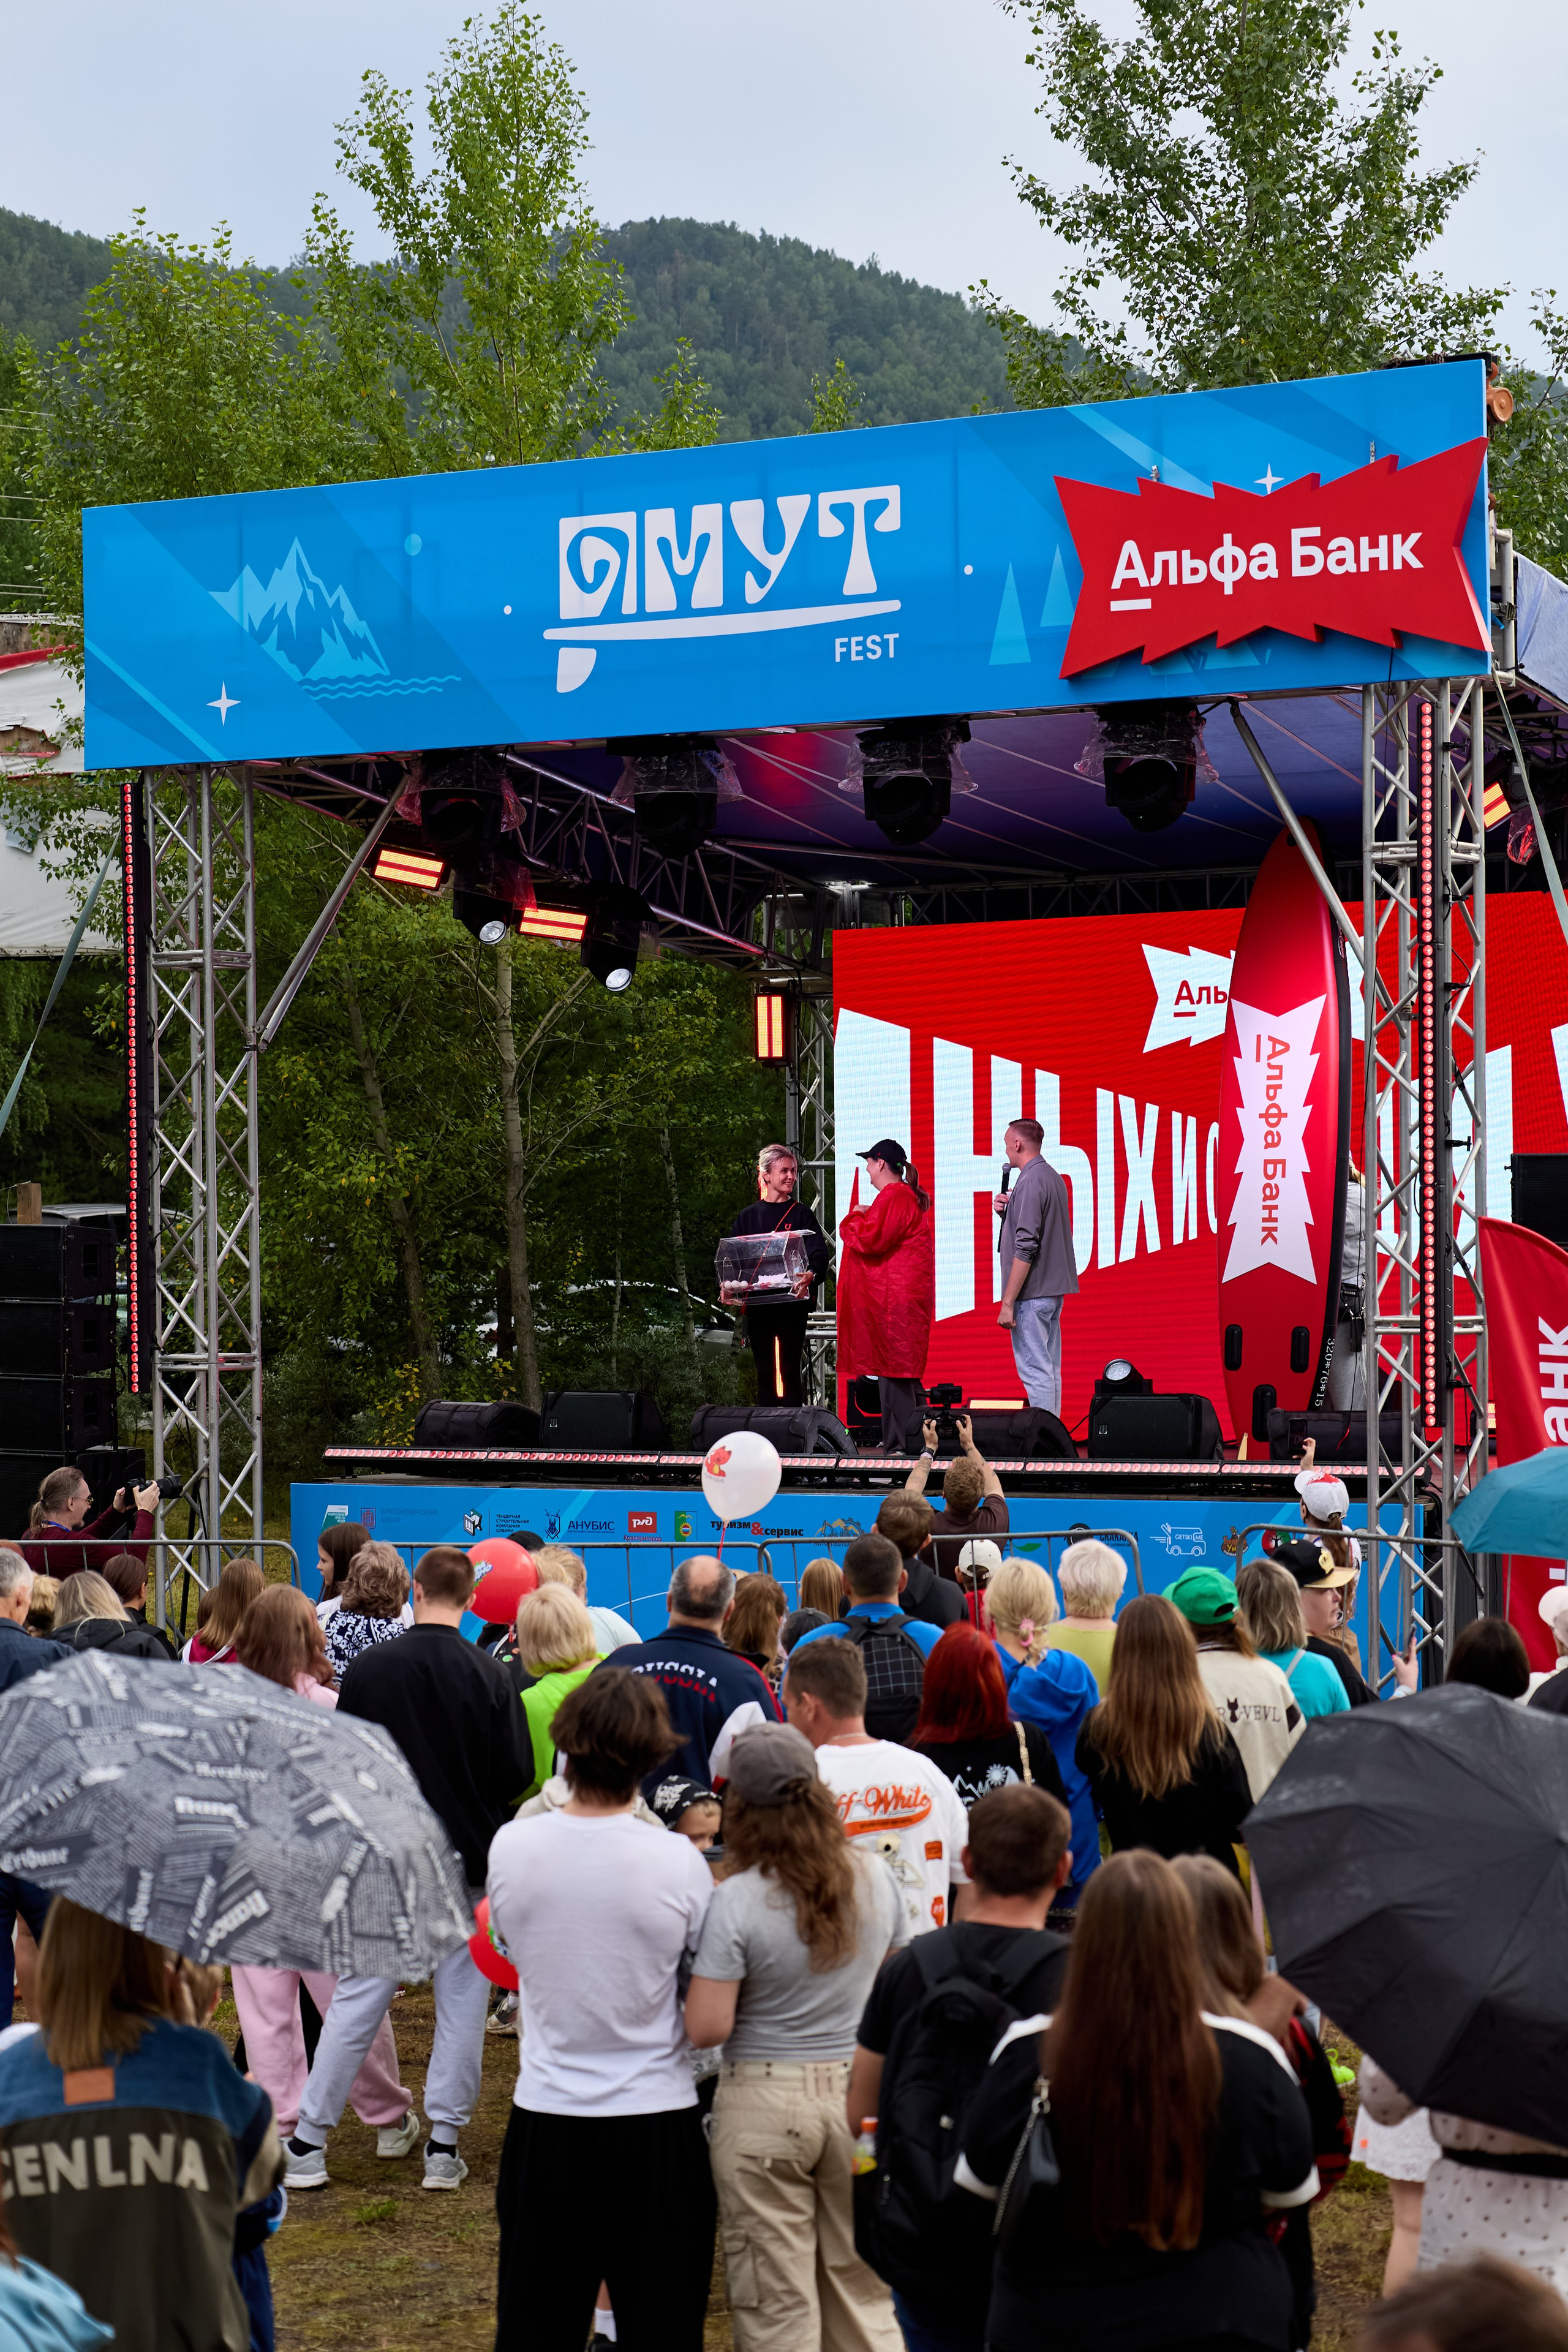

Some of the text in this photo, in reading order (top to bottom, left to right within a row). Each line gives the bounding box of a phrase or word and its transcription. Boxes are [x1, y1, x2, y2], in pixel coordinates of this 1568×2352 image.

[1110, 526, 1424, 596] Альфа Банк
[835, 633, 900, 663] FEST
[1174, 979, 1228, 1006] Аль
[1259, 1035, 1291, 1246] Альфа Банк
[1537, 1316, 1568, 1450] анк
[381, 1507, 438, 1516] КРАСНОЯРСКИЙ
[568, 1520, 615, 1531] АНУБИС
[836, 1785, 932, 1822] ff-White
